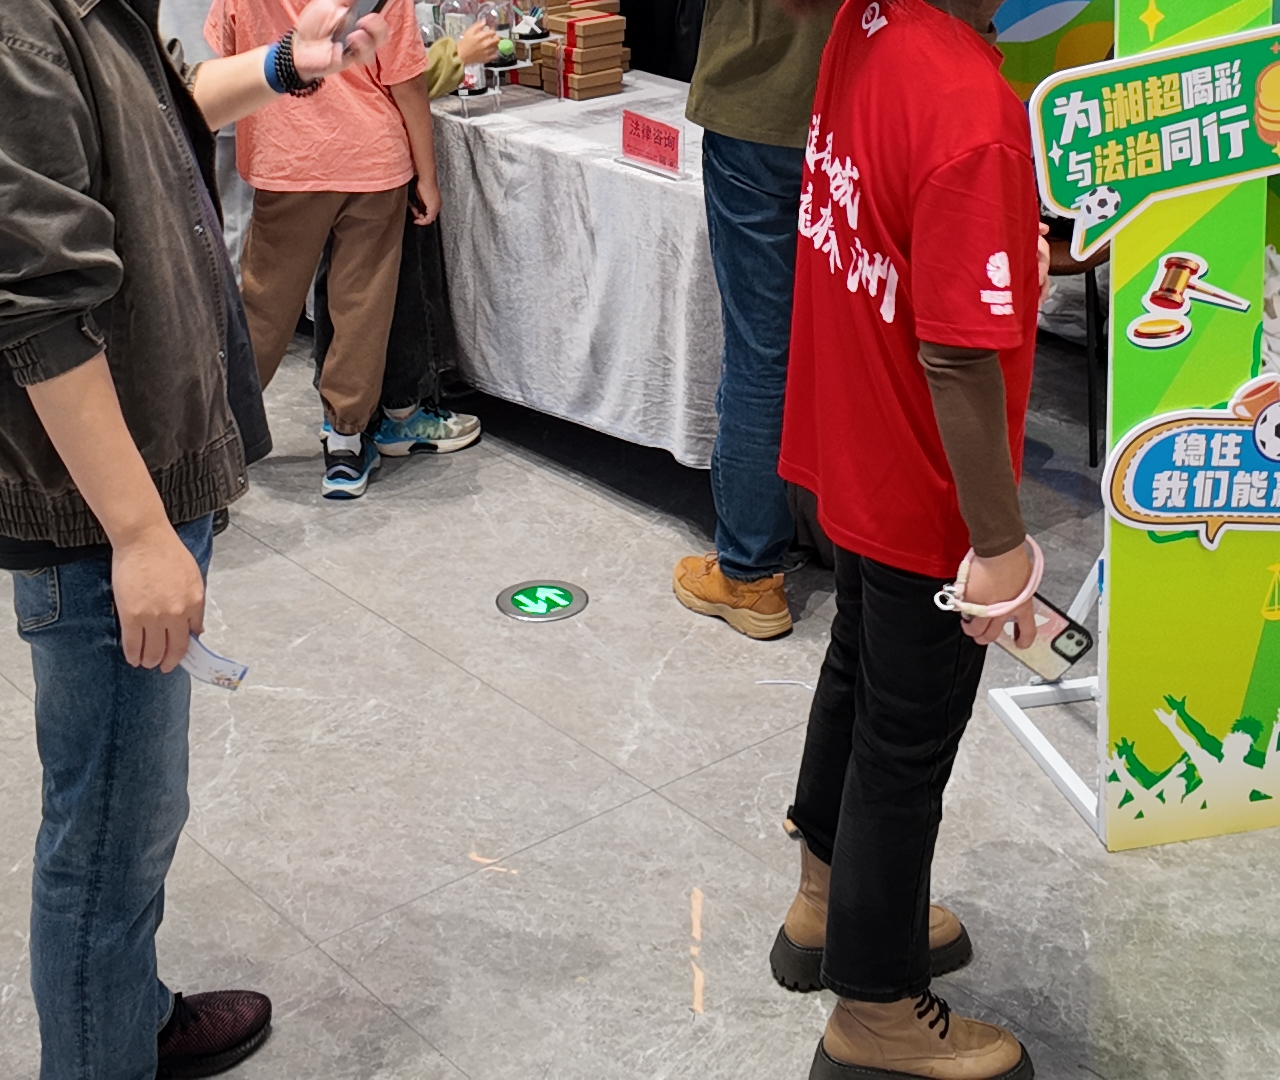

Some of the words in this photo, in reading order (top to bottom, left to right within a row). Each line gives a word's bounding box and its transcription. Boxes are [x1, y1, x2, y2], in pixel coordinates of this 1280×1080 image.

[1053, 59, 1243, 146] 为湘超喝彩
[629, 119, 676, 152] 法律咨询
[1066, 104, 1250, 188] 与法治同行
[1172, 433, 1243, 467] 稳住
